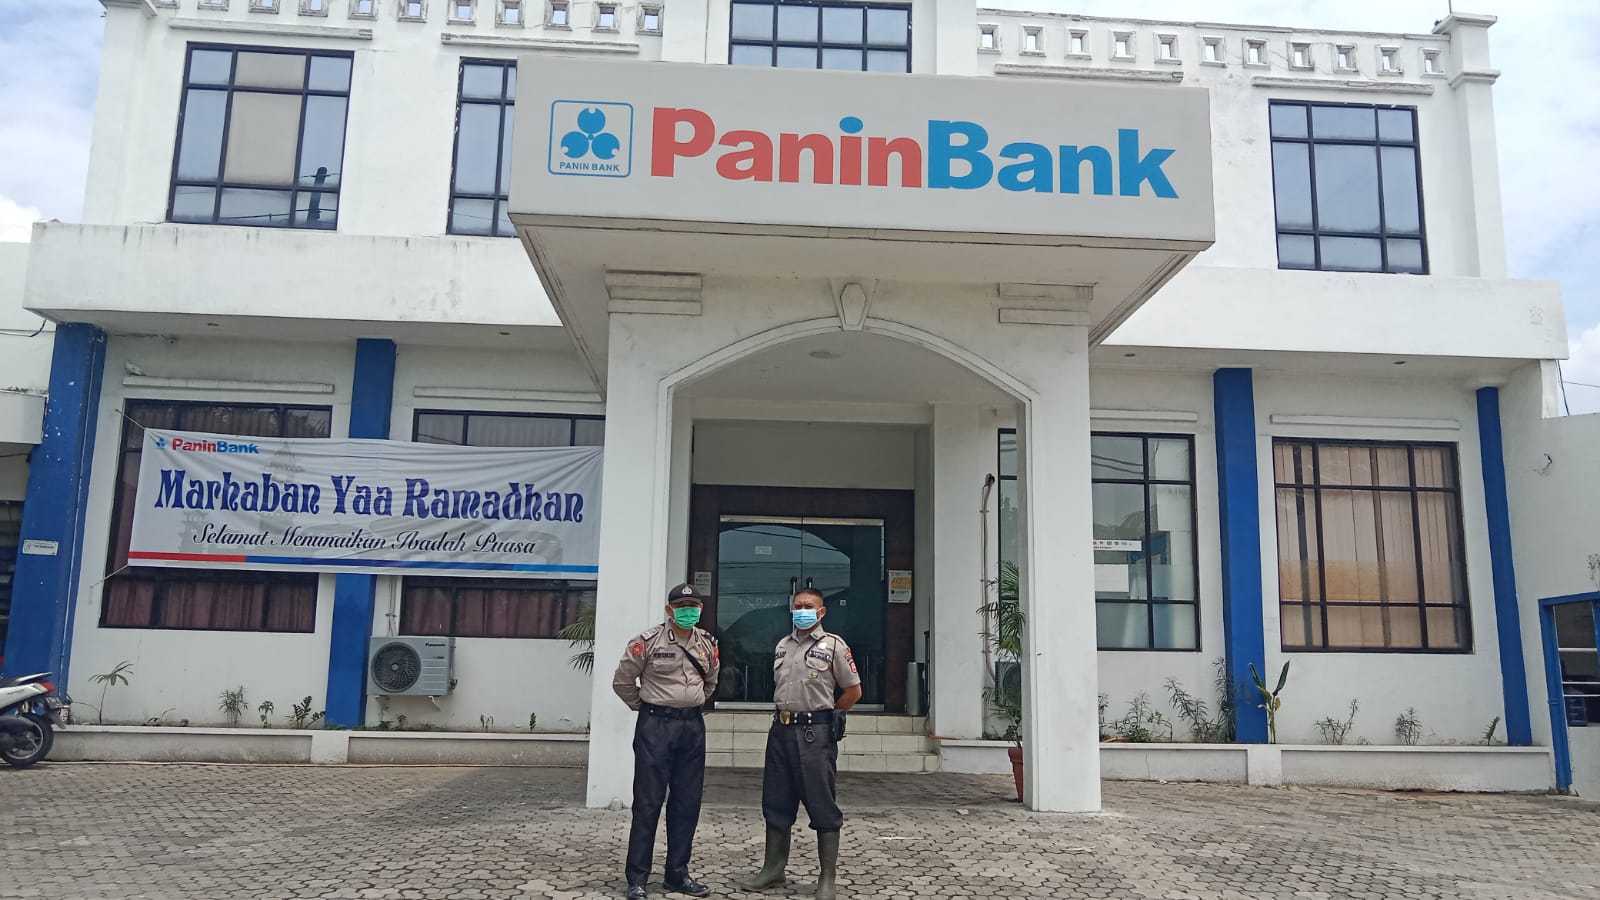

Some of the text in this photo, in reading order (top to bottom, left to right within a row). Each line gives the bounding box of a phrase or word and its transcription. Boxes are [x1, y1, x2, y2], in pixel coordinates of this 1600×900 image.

[559, 161, 620, 172] PANIN BANK
[650, 106, 1179, 199] PaninBank
[172, 437, 260, 454] PaninBank
[154, 469, 585, 524] Marhaban Yaa Ramadhan
[192, 523, 537, 555] Selamat Menunaikan Ibadah Puasa
